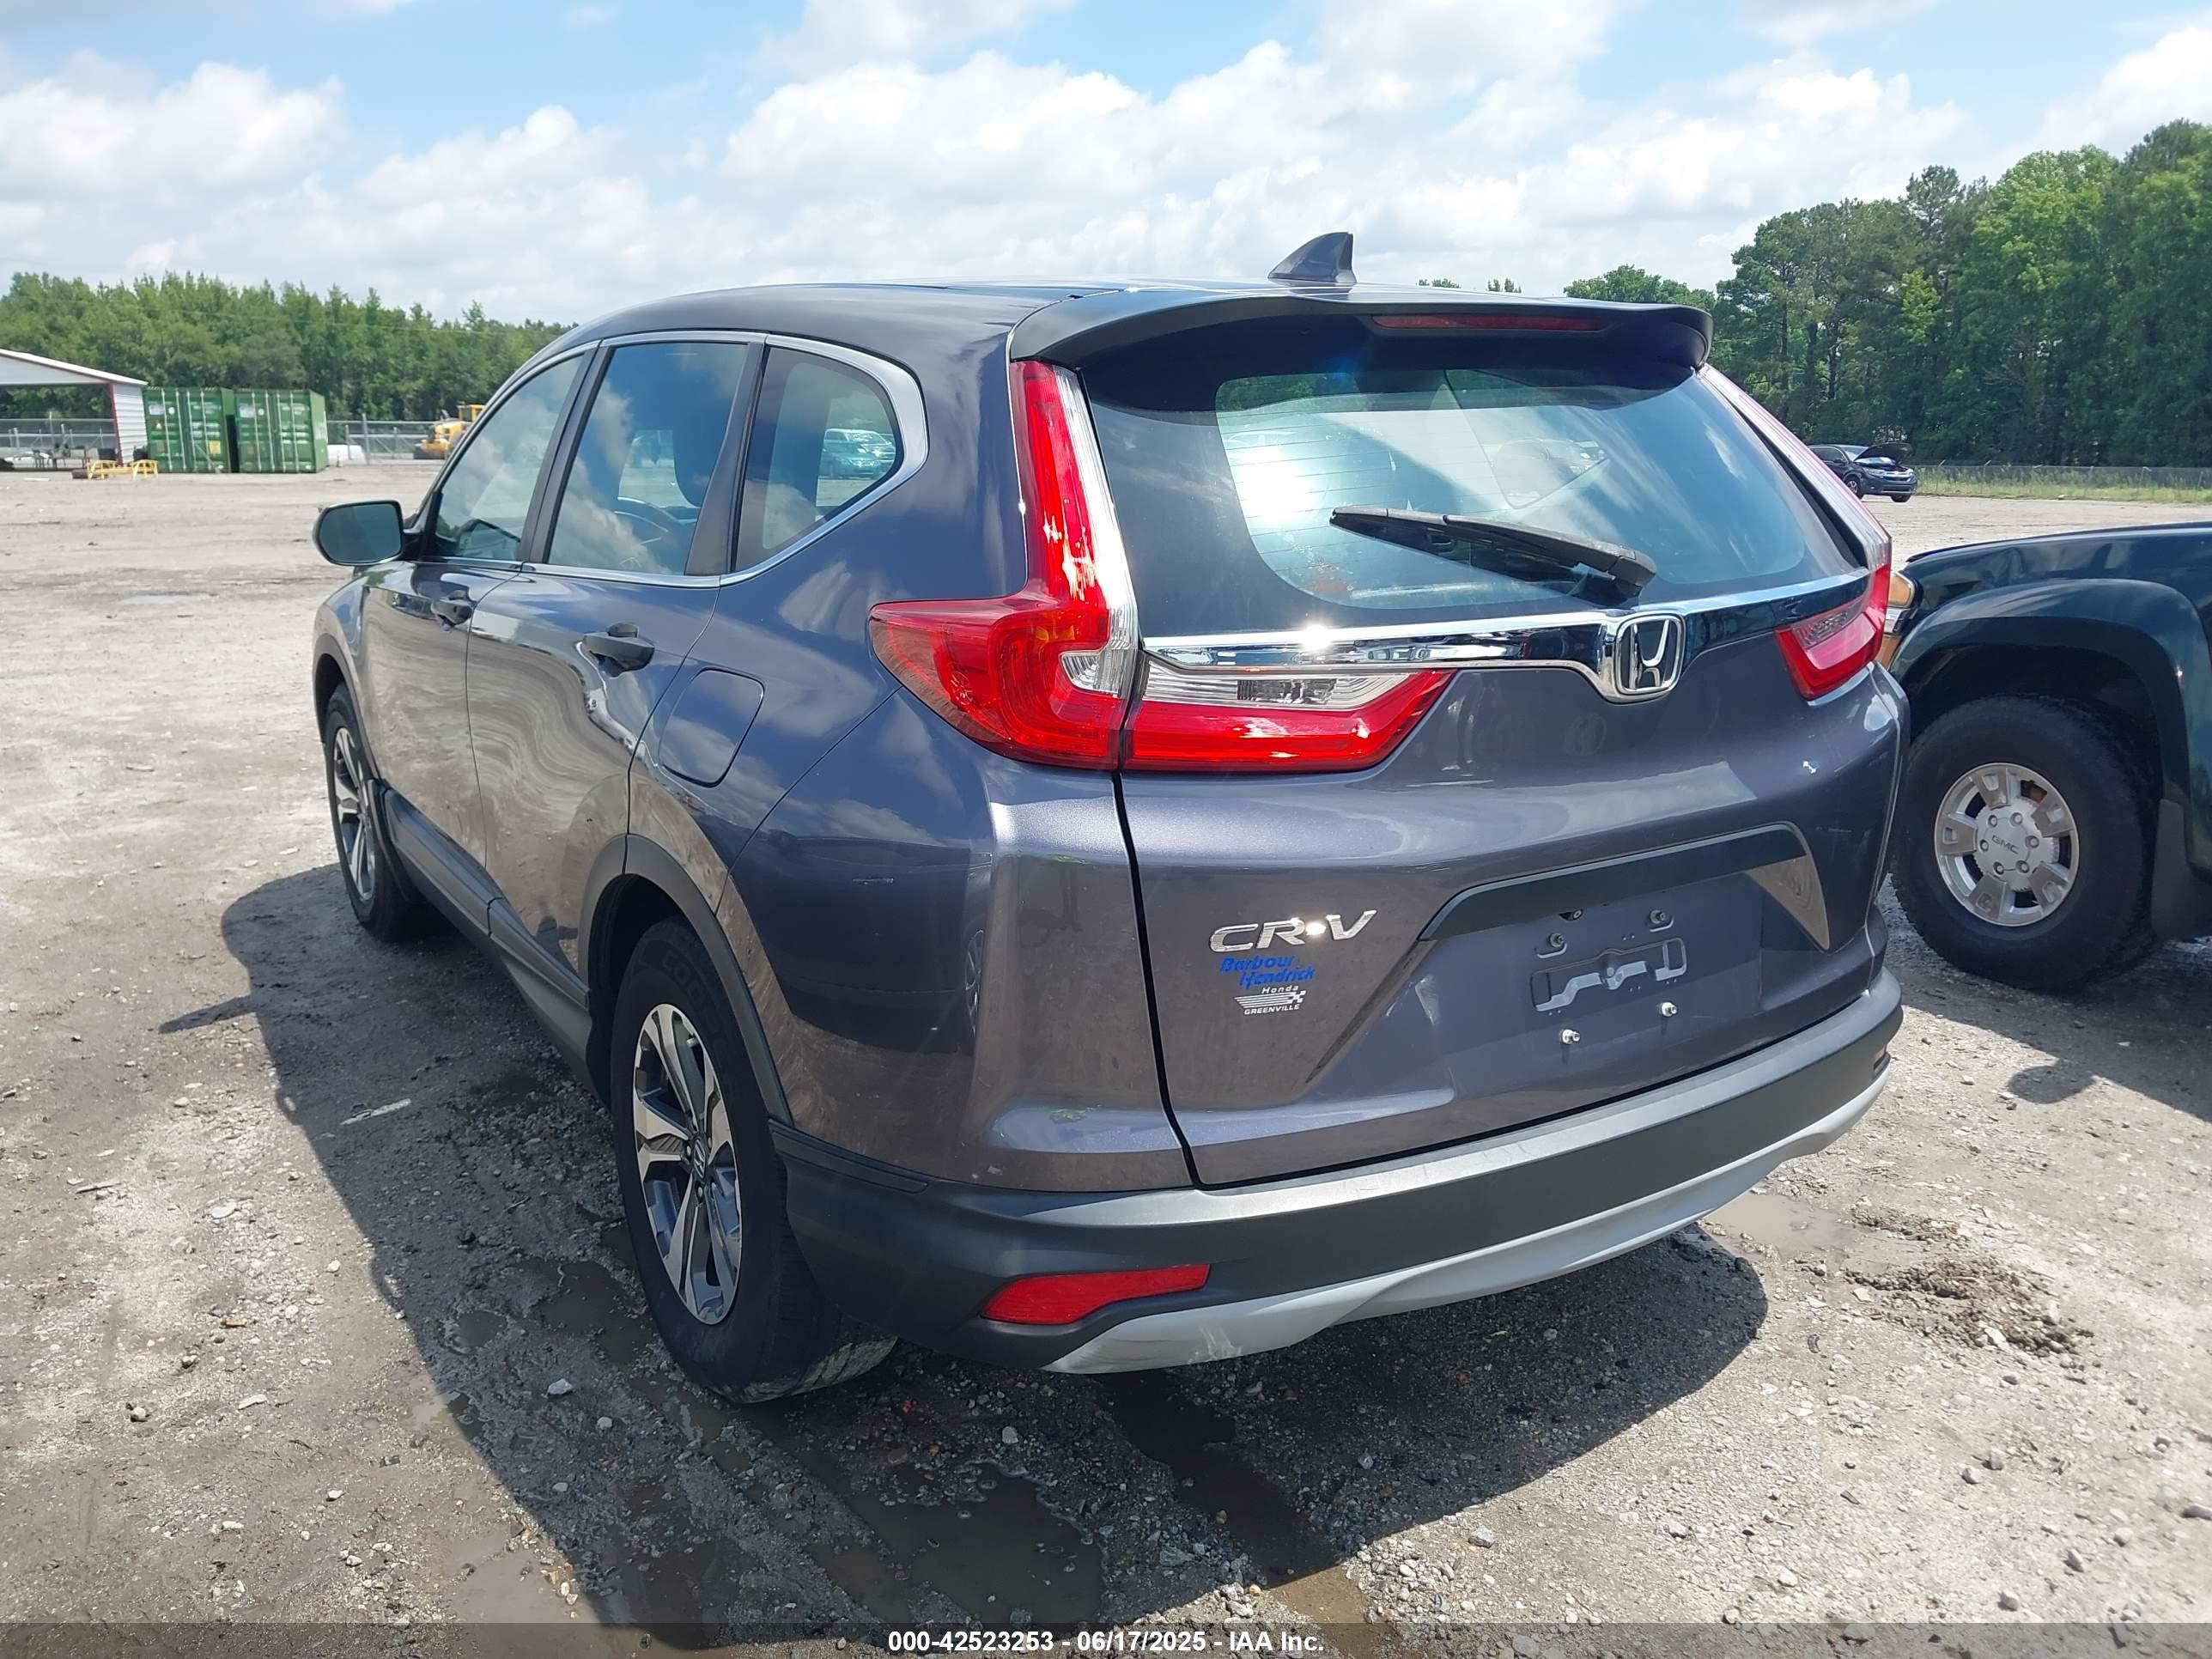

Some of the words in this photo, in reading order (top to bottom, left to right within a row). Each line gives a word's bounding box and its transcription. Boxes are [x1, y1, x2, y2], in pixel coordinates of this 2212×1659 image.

[1992, 835, 2019, 854] GMC
[1209, 909, 1377, 952] CR-V
[1219, 955, 1295, 973] Barbour
[1238, 965, 1316, 989] Hendrick
[1261, 985, 1299, 994] Honda
[1243, 1004, 1301, 1015] GREENVILLE
